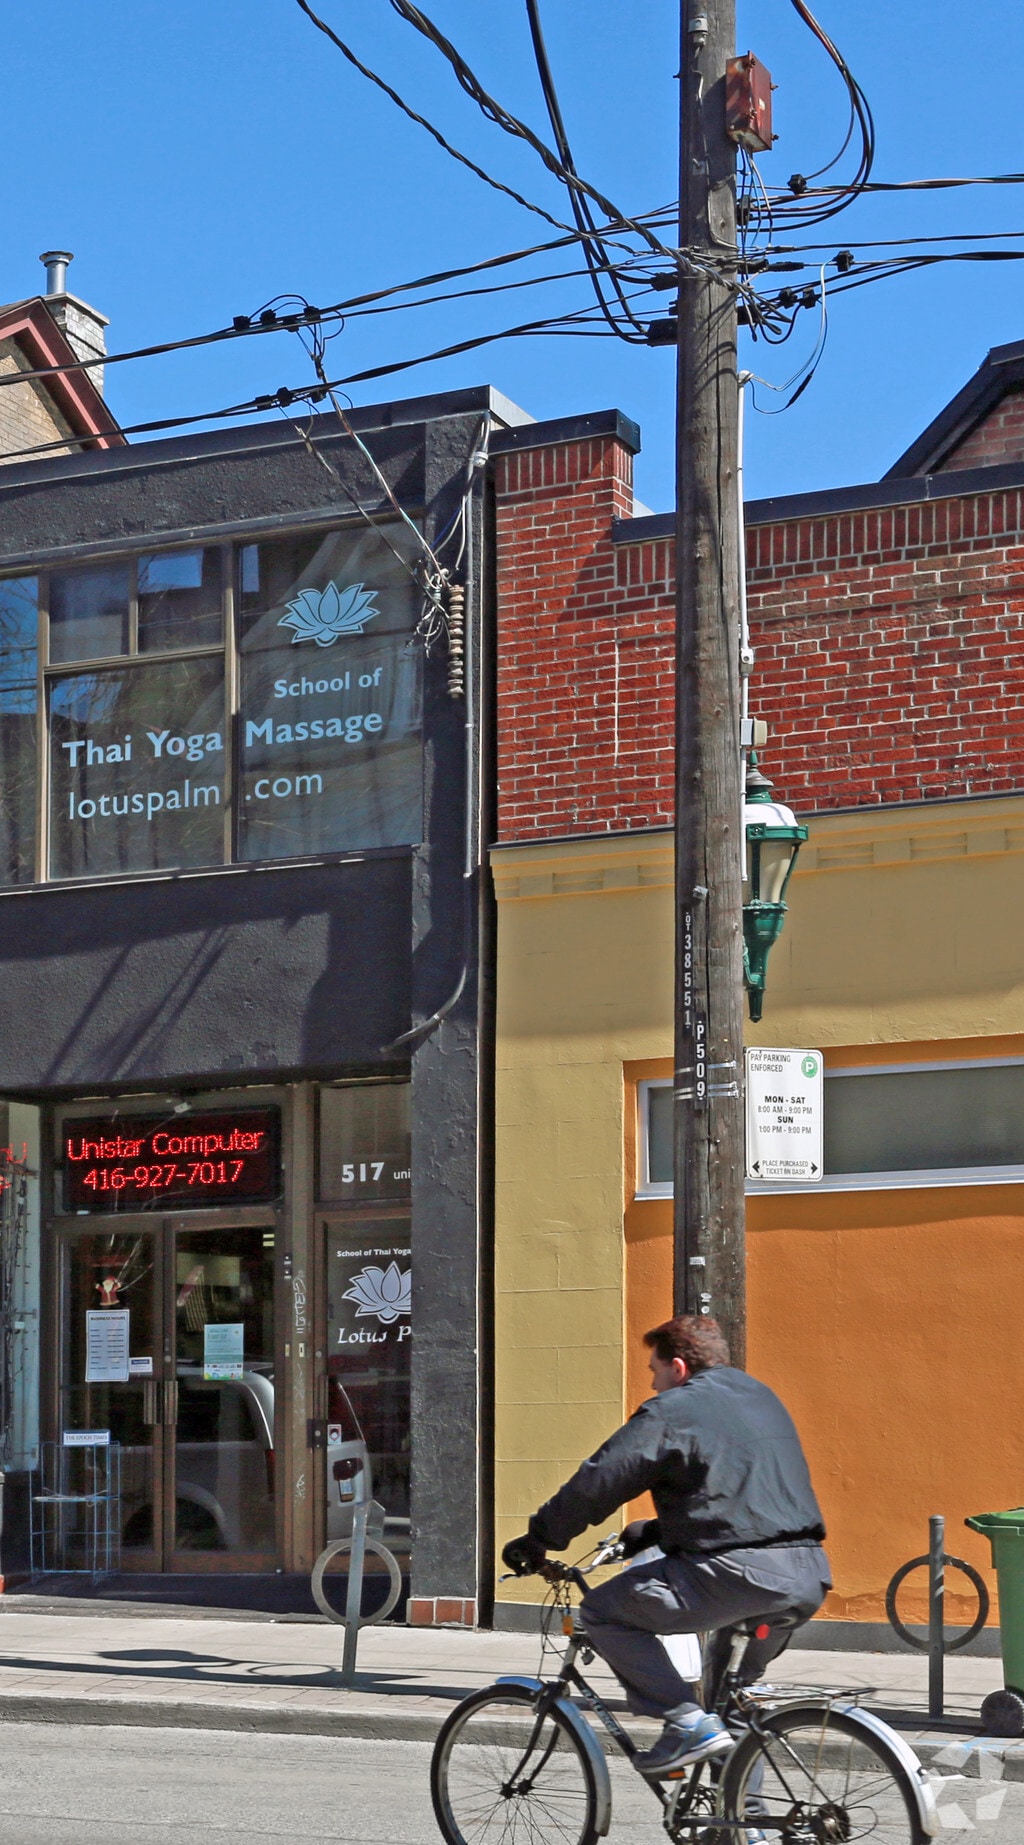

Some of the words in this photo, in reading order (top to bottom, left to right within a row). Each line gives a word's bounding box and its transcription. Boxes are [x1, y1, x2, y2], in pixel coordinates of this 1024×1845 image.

[274, 672, 350, 698] School
[358, 668, 383, 688] of
[62, 735, 132, 768] Thai
[146, 730, 224, 762] Yoga
[245, 712, 383, 747] Massage
[750, 1053, 762, 1061] PAY
[763, 1054, 791, 1063] PARKING
[750, 1064, 783, 1072] ENFORCED
[764, 1096, 783, 1104] MON
[790, 1096, 806, 1104] SAT
[758, 1105, 771, 1113] 8:00
[789, 1106, 801, 1114] 9:00
[802, 1106, 813, 1114] PM
[777, 1116, 794, 1124] SUN
[759, 1125, 771, 1133] 1:00
[787, 1126, 800, 1134] 9:00
[802, 1126, 812, 1134] PM
[67, 1135, 146, 1161] Unistar
[152, 1128, 265, 1157] Computer
[762, 1159, 778, 1167] PLACE
[779, 1160, 808, 1168] PURCHASED
[83, 1160, 245, 1190] 416-927-7017
[341, 1162, 385, 1183] 517
[393, 1168, 411, 1180] uni
[337, 1249, 362, 1257] School
[373, 1248, 391, 1256] Thai
[393, 1248, 411, 1256] Yoga
[337, 1327, 387, 1344] Lotus
